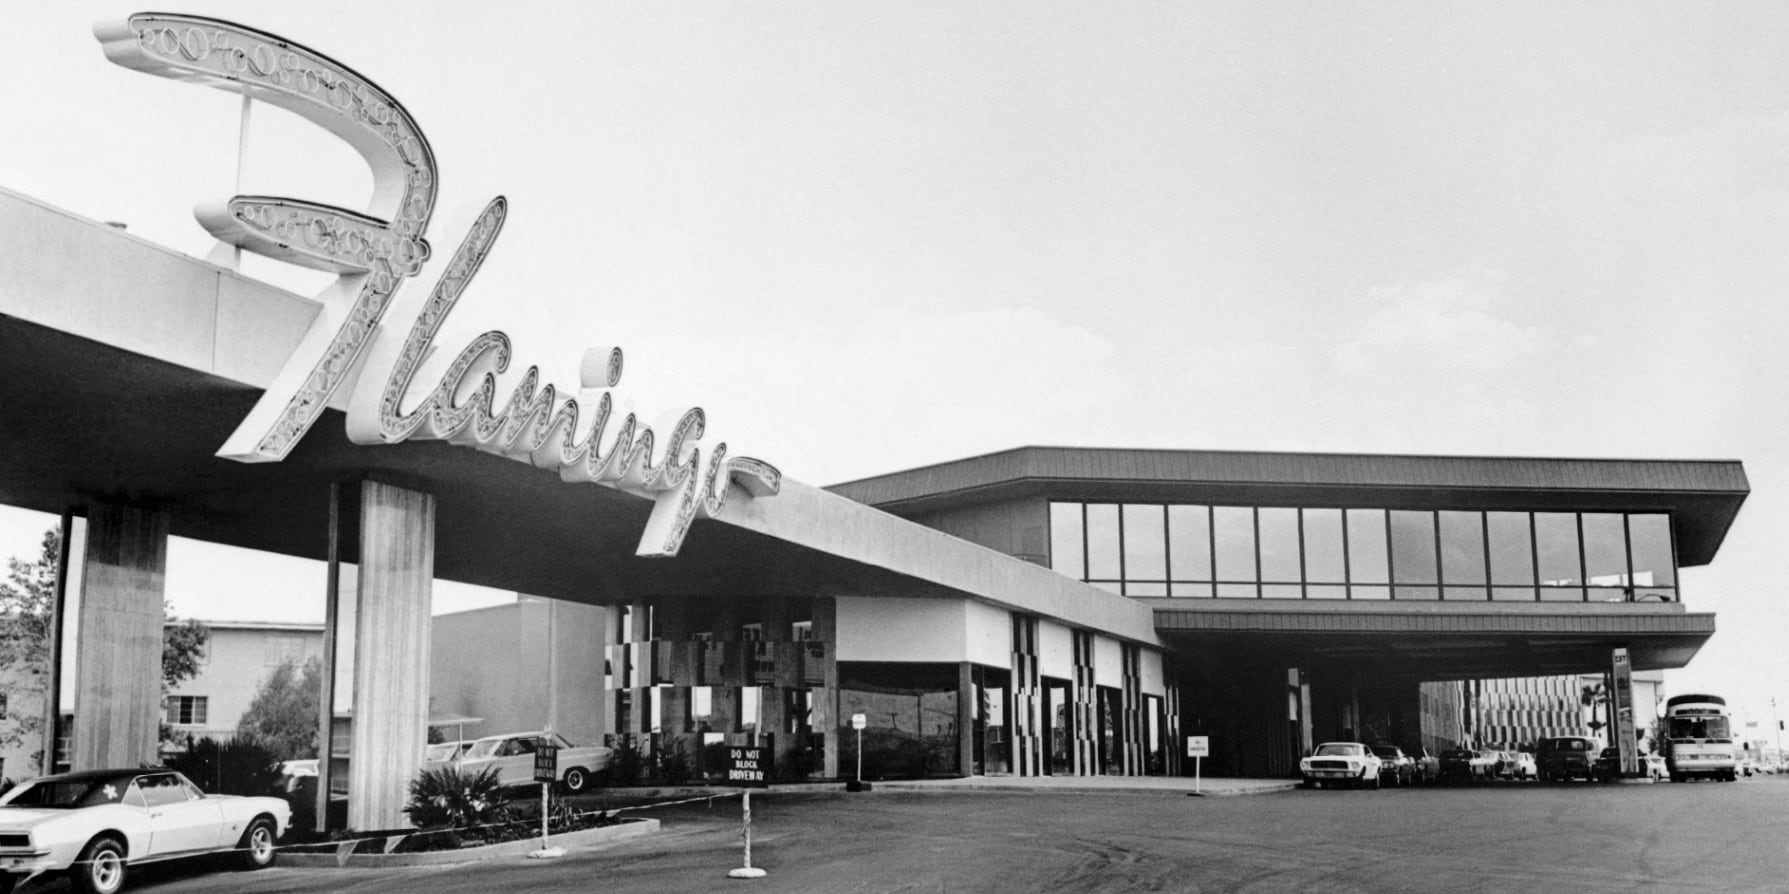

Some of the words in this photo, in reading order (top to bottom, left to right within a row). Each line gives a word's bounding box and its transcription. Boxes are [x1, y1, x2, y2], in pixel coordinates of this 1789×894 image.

[93, 11, 782, 558] Flamingo
[731, 749, 742, 759] DO
[745, 750, 760, 759] NOT
[735, 760, 758, 769] BLOCK
[729, 769, 765, 780] DRIVEWAY
